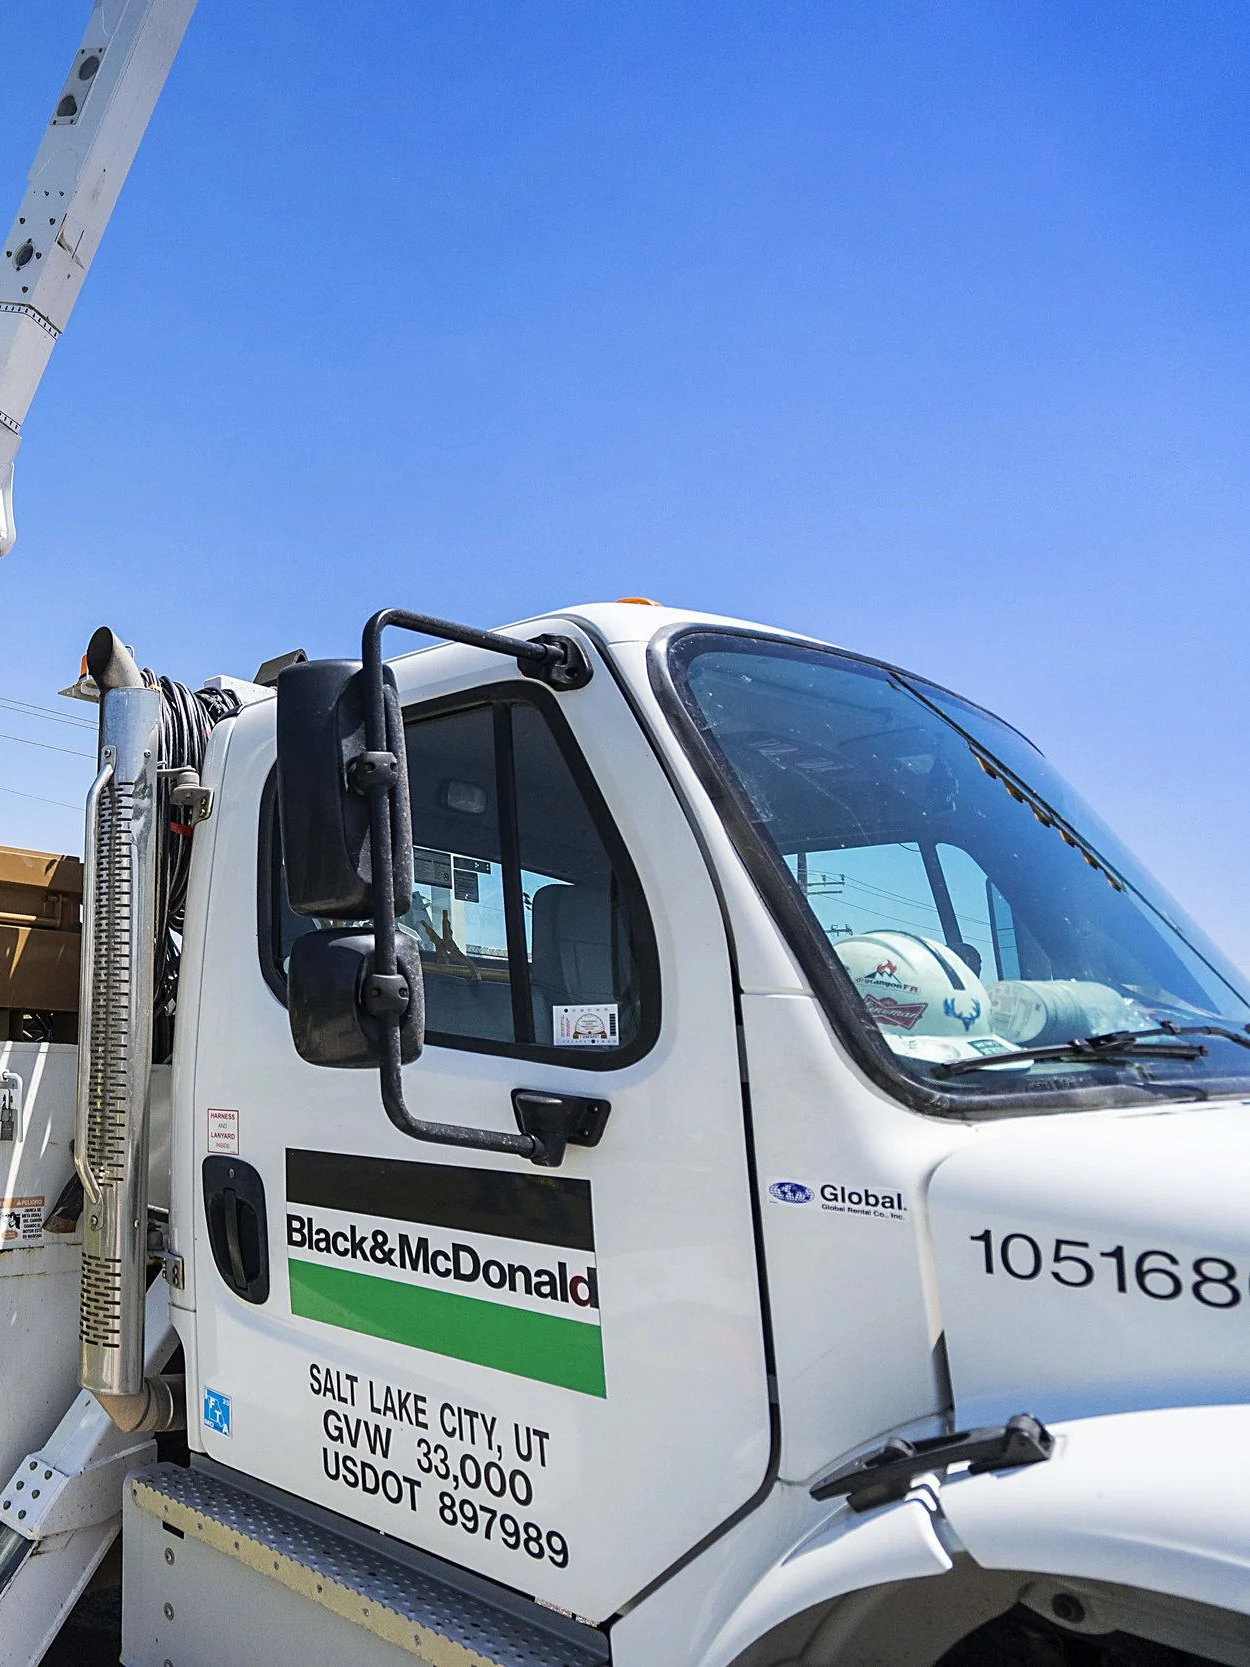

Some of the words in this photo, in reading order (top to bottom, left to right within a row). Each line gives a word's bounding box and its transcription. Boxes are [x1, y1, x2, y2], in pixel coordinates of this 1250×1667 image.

[210, 1132, 235, 1140] LANYARD
[820, 1184, 903, 1211] Global
[821, 1203, 846, 1212] Global
[847, 1207, 871, 1216] Rental
[890, 1212, 905, 1220] Inc.
[286, 1213, 599, 1309] Black&McDonald
[970, 1229, 1250, 1309] 105168
[309, 1363, 358, 1407] SALT
[369, 1380, 429, 1430] LAKE
[439, 1402, 502, 1462] CITY,
[513, 1423, 550, 1468] UT
[323, 1409, 392, 1459] GVW
[416, 1438, 533, 1507] 33,000
[322, 1447, 422, 1512] USDOT
[438, 1491, 569, 1569] 897989
